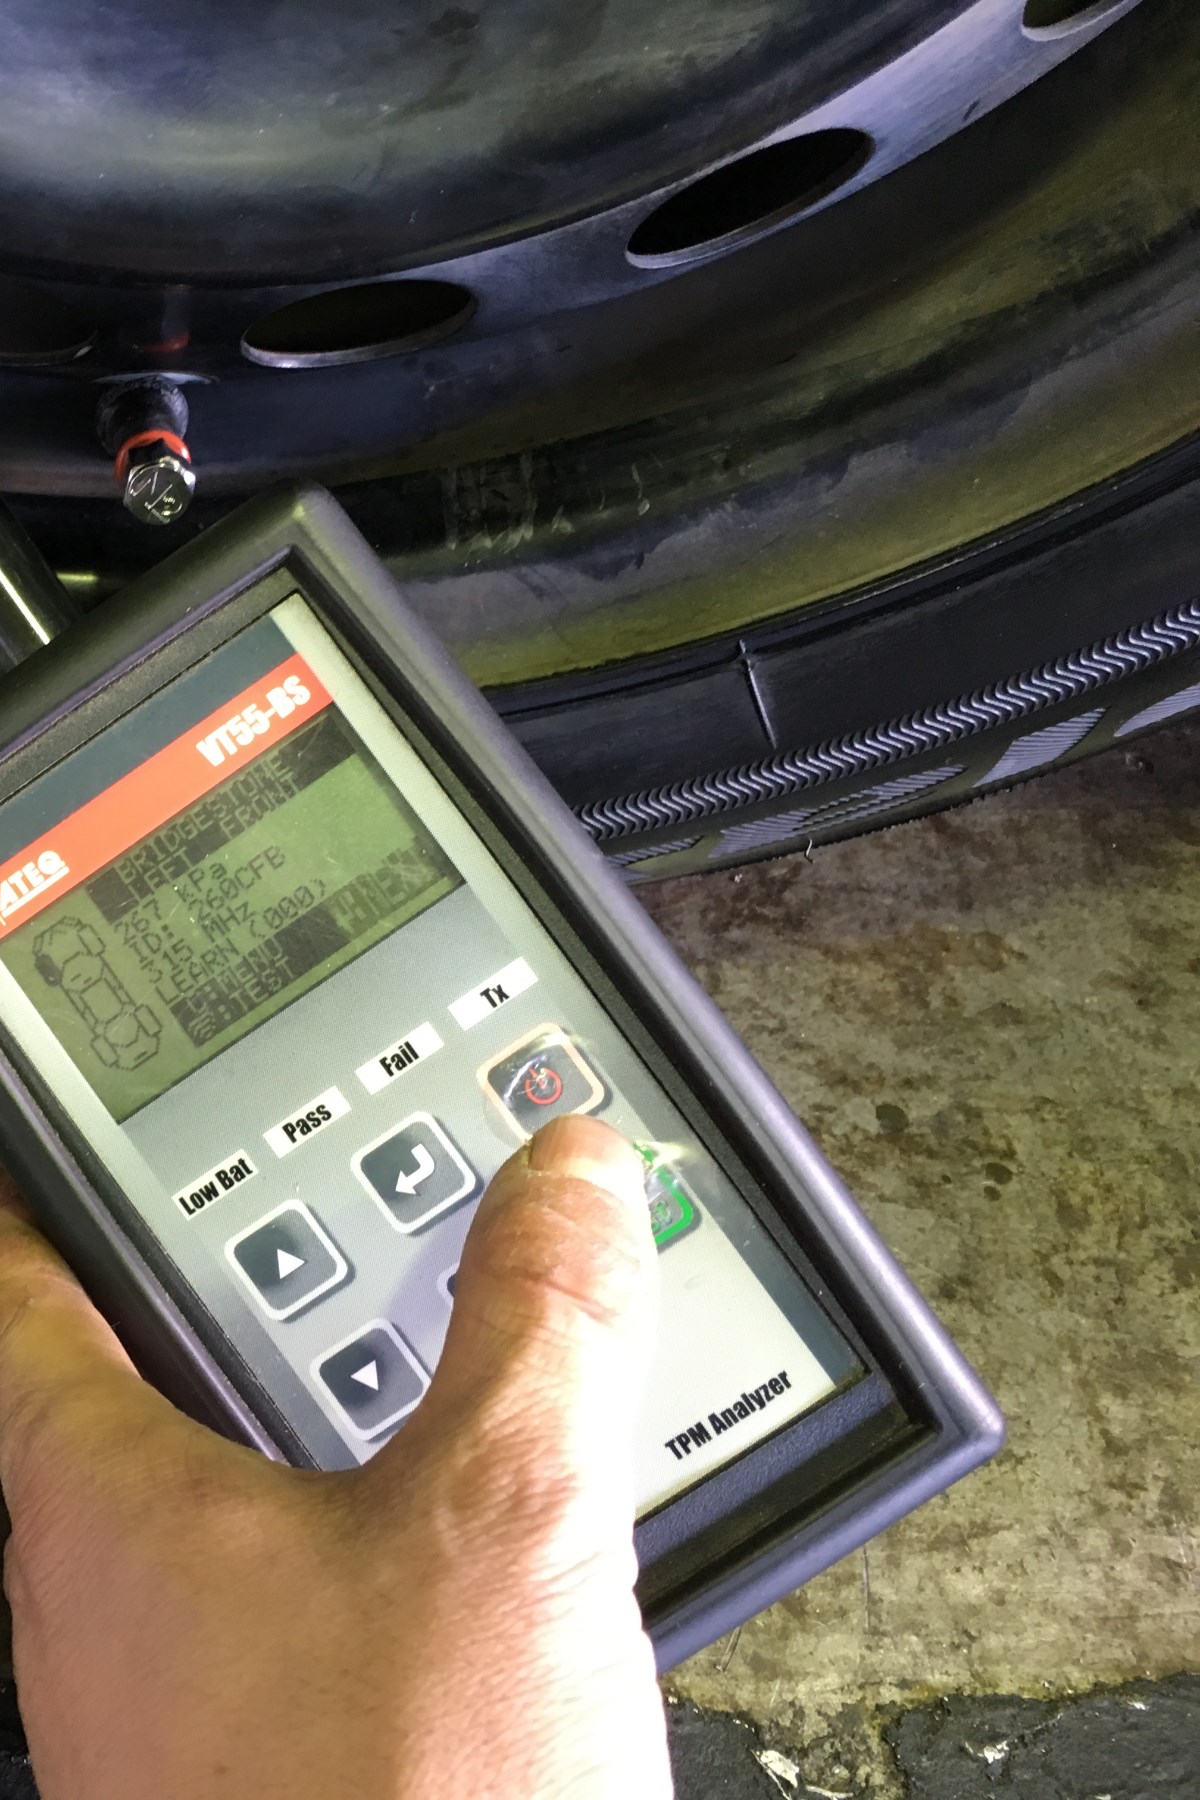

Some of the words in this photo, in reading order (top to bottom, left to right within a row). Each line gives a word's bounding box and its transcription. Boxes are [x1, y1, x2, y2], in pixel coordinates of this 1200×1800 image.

[195, 672, 313, 771] VT55-BS
[112, 750, 290, 884] BRIDGESTONE
[129, 847, 196, 904] LEFT
[218, 772, 304, 841] FRONT
[0, 850, 66, 910] ATEQ
[111, 897, 167, 946] 267
[171, 854, 228, 903] kPa
[128, 921, 177, 965] ID:
[140, 937, 196, 986] 315
[200, 894, 257, 943] MHz
[155, 937, 241, 1006] LEARN
[479, 983, 510, 1010] Tx
[378, 1040, 420, 1077] Fail
[281, 1103, 332, 1144] Pass
[178, 1174, 220, 1216] Low
[214, 1157, 253, 1189] Bat
[665, 1420, 712, 1461] TPM
[709, 1369, 792, 1432] Analyzer
